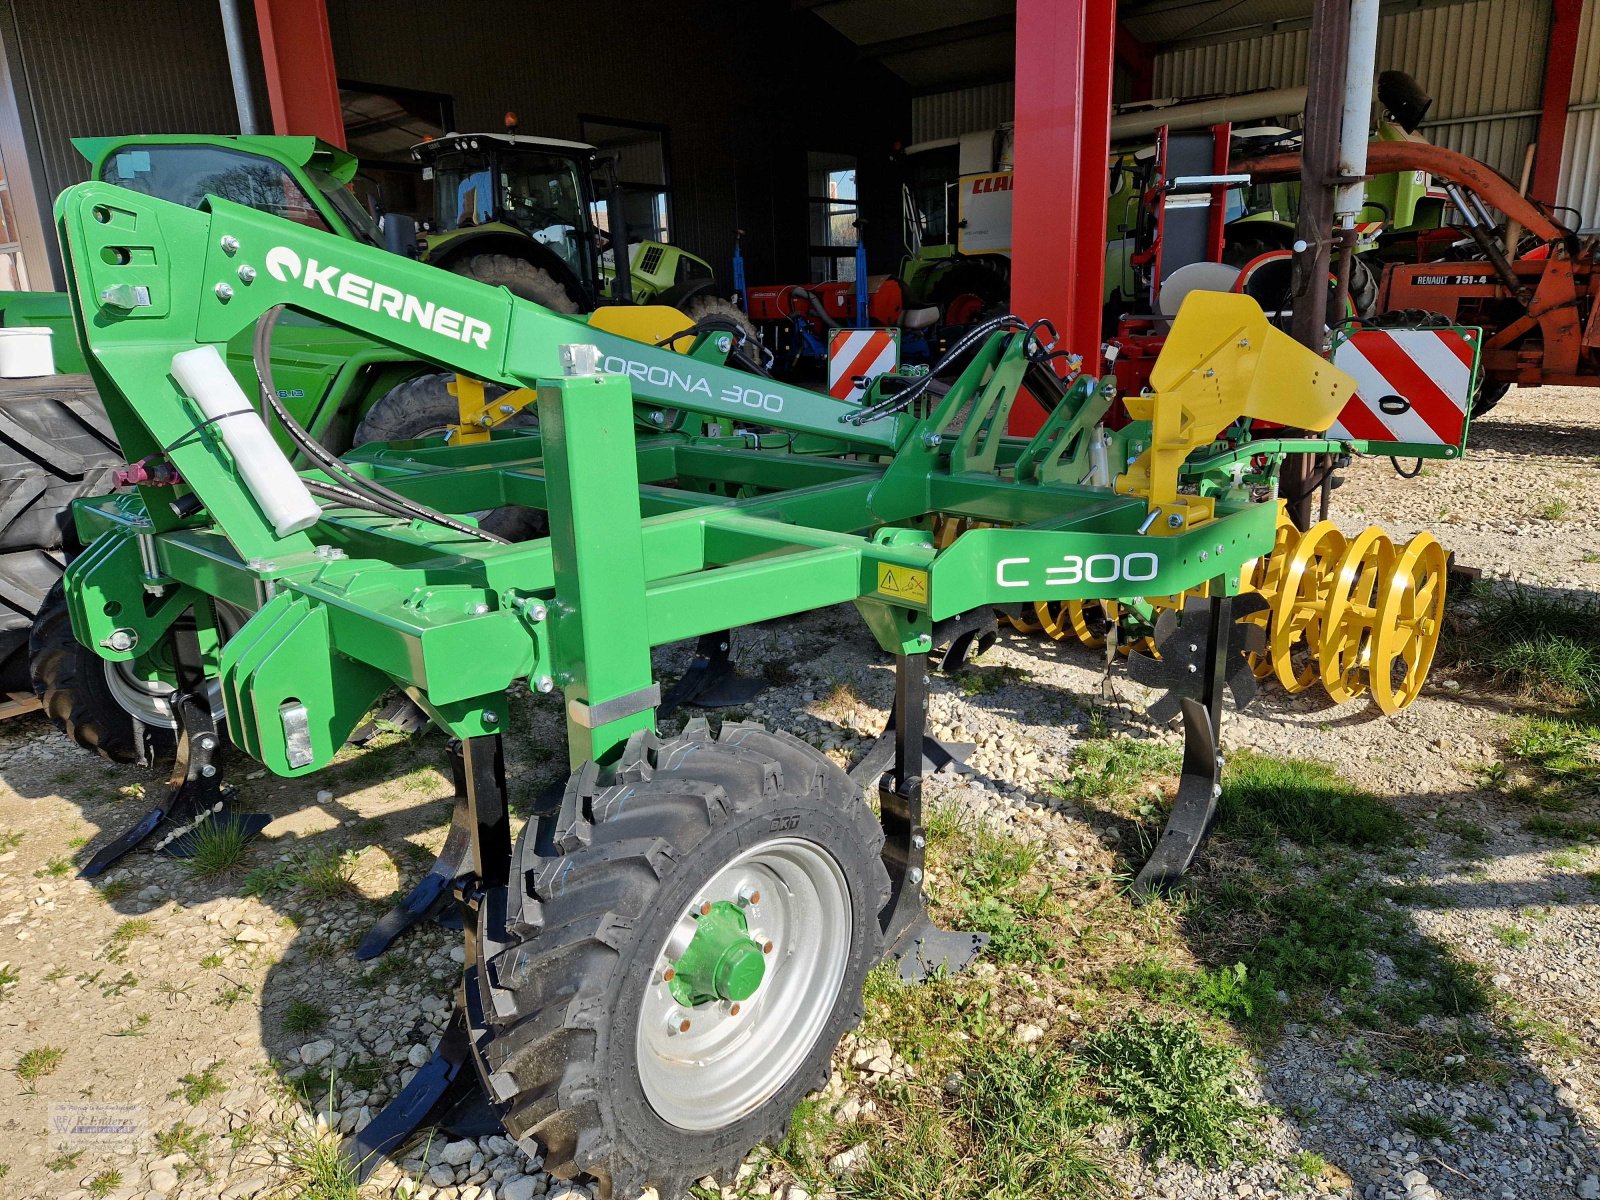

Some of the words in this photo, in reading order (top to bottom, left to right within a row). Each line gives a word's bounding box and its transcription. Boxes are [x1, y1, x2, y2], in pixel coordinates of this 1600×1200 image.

[1417, 275, 1449, 285] RENAULT
[302, 257, 492, 350] KERNER
[594, 356, 713, 398] ORONA
[720, 385, 784, 413] 300
[996, 557, 1031, 587] C
[1045, 552, 1159, 586] 300
[769, 815, 801, 833] BKT
